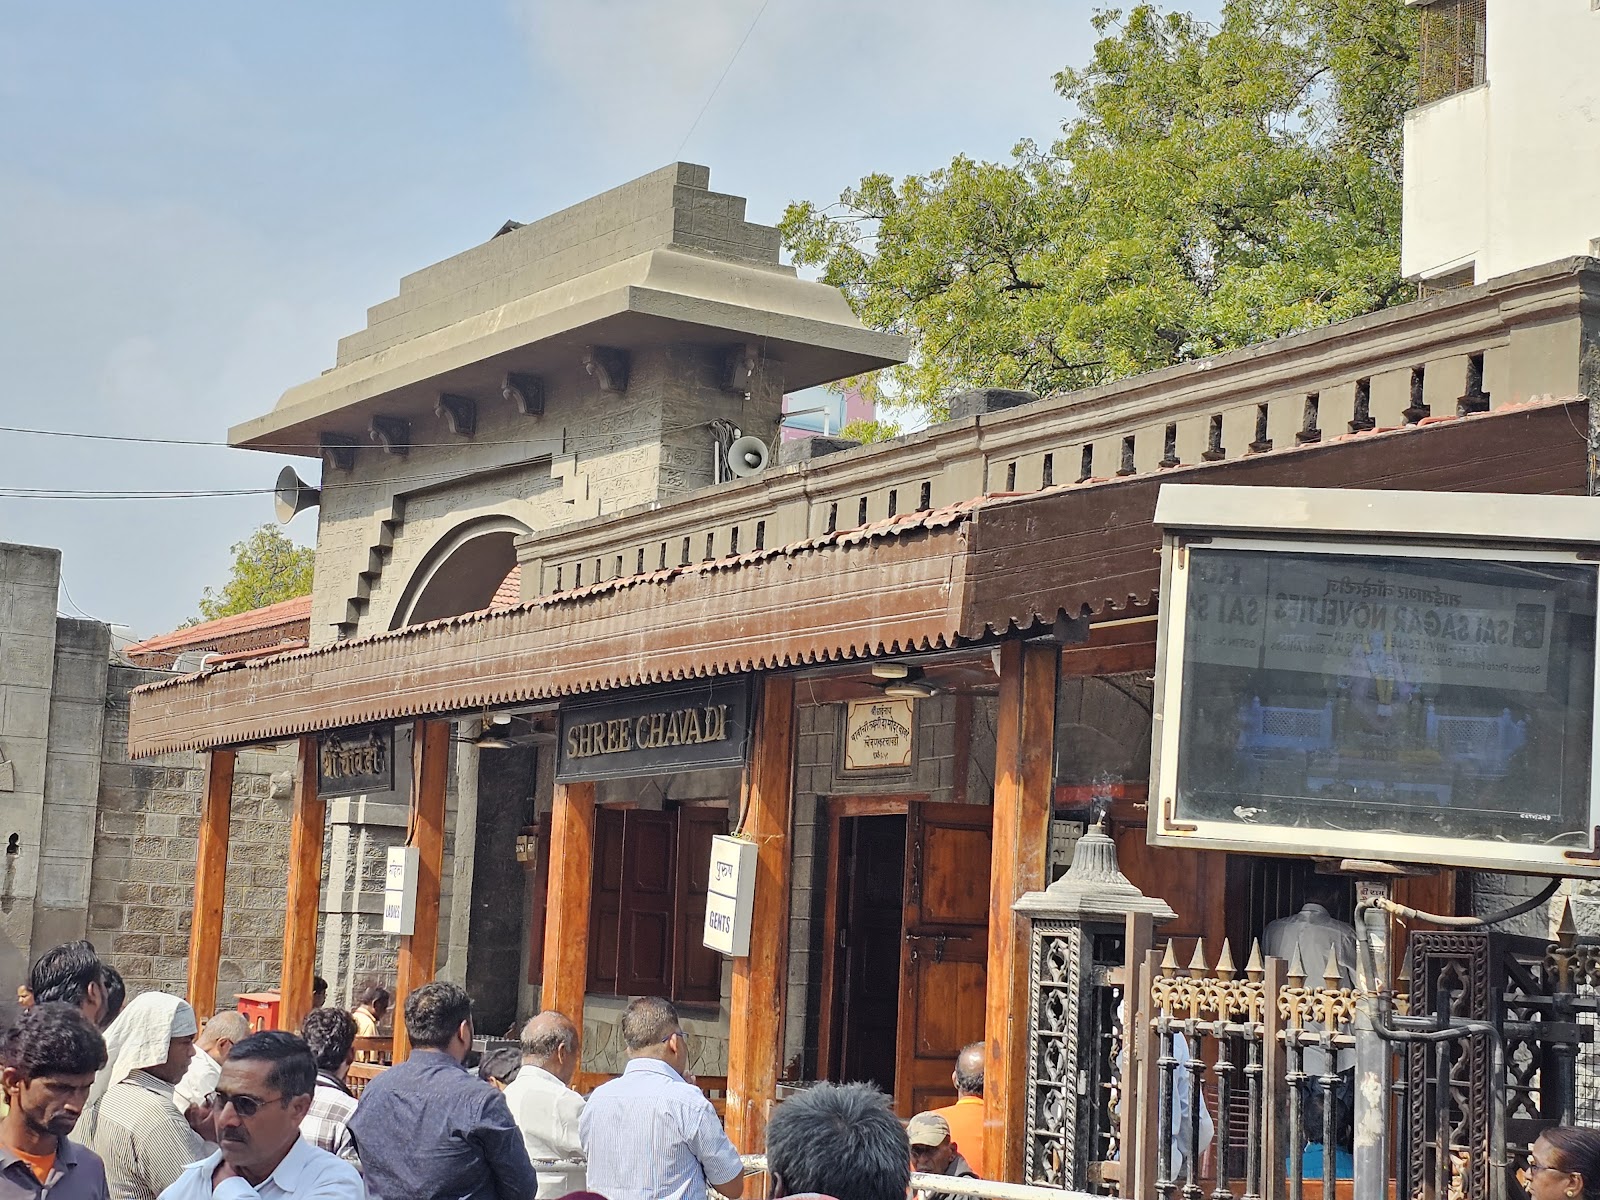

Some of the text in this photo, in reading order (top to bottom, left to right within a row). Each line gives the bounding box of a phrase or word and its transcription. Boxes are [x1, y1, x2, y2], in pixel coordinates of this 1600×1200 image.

[566, 704, 728, 759] SHREE CHAVADI
[386, 904, 400, 918] LADIES
[709, 910, 731, 934] GENTS
